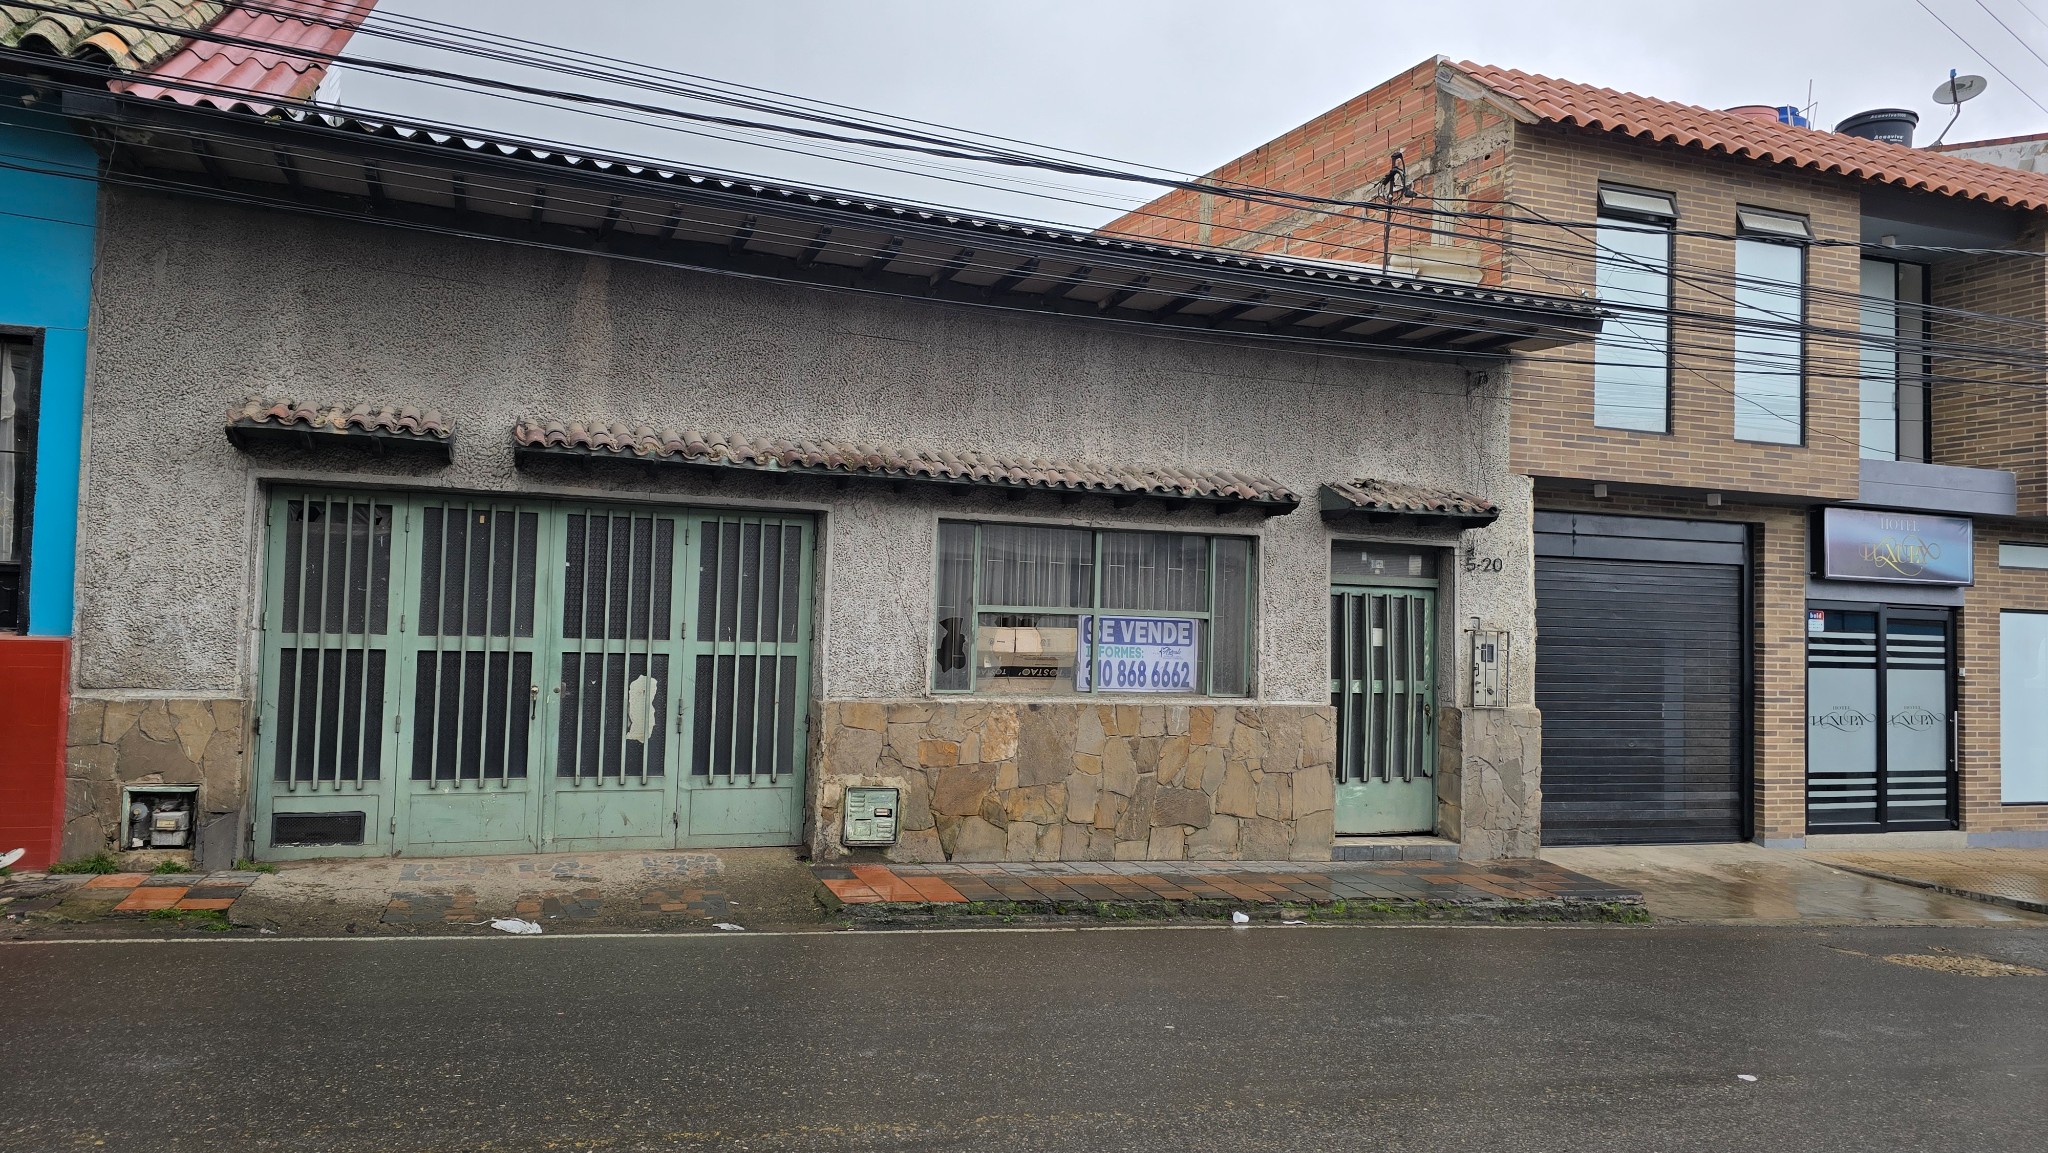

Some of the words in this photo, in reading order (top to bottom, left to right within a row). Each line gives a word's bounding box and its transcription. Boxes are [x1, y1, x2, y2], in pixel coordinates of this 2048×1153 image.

[1880, 518, 1920, 531] HOTEL
[1860, 535, 1941, 576] LUXURY
[1120, 620, 1190, 644] VENDE
[1085, 646, 1144, 658] IFORMES:
[1117, 660, 1147, 687] 868
[1151, 661, 1190, 688] 6662
[1808, 710, 1876, 732] LUXURY
[1887, 709, 1946, 731] UXURY
